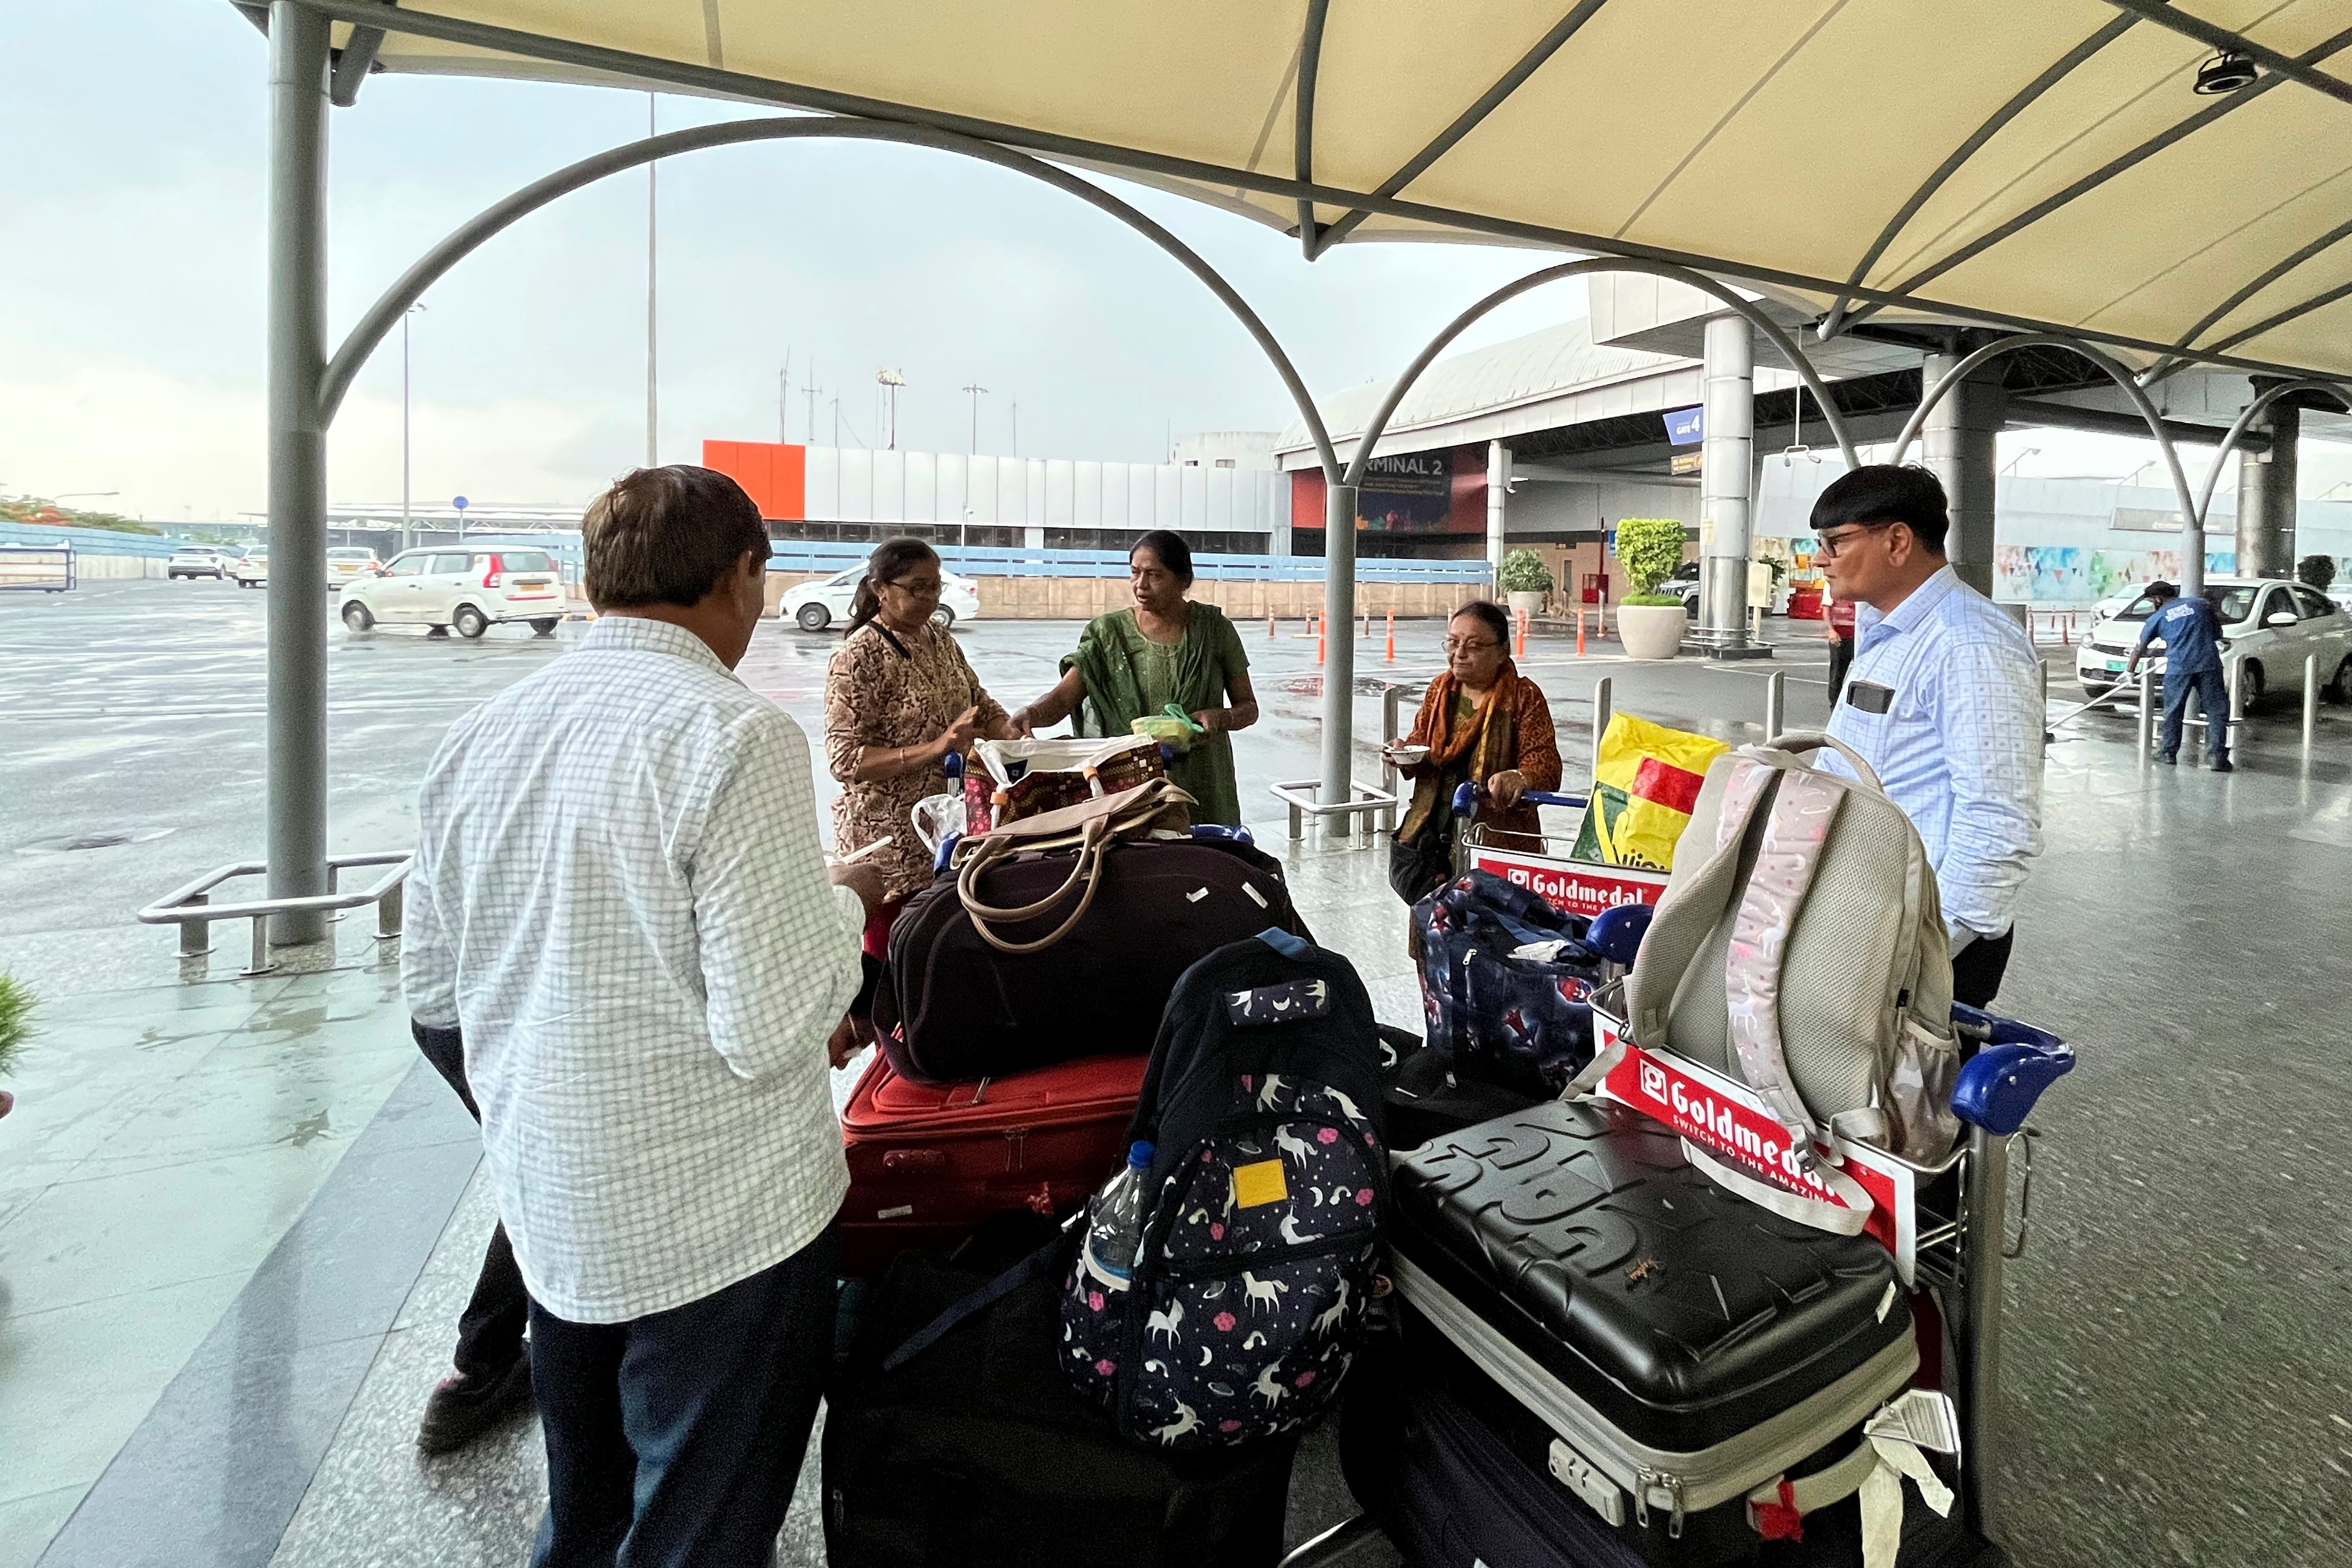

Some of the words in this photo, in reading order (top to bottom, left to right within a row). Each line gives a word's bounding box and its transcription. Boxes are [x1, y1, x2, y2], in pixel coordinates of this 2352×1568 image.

[1691, 415, 1700, 432] 4
[1432, 460, 1443, 475] 2
[1533, 873, 1643, 906] Goldmedal
[1567, 900, 1579, 908] TO
[1582, 902, 1598, 912] THE
[1673, 1114, 1715, 1146] SWITCH
[1720, 1140, 1736, 1157] TO
[1740, 1152, 1764, 1174] THE
[1769, 1170, 1835, 1206] AMAZIN
